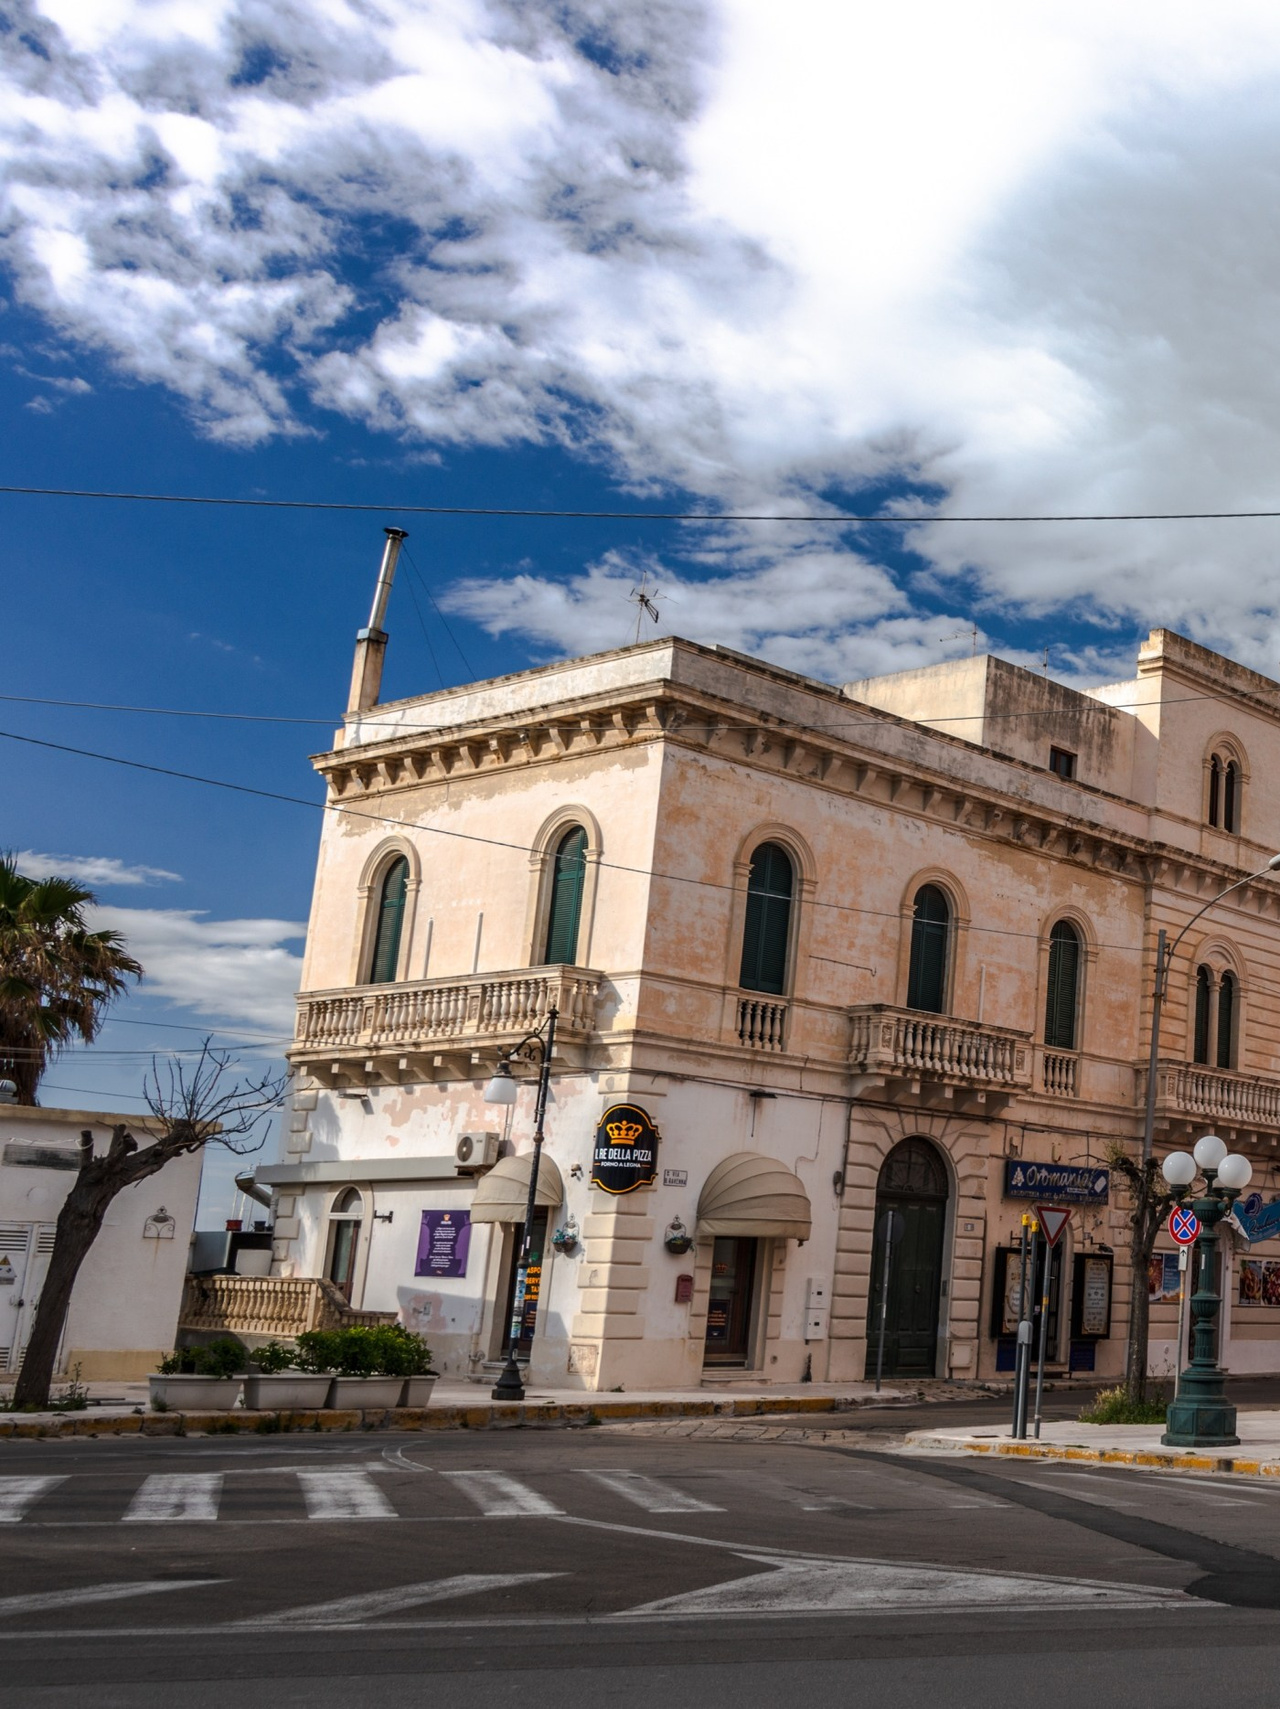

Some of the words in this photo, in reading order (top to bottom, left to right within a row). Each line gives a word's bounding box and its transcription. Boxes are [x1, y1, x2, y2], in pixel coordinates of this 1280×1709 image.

[599, 1148, 608, 1160] RE
[608, 1148, 631, 1160] DELLA
[632, 1149, 652, 1162] PIZZA
